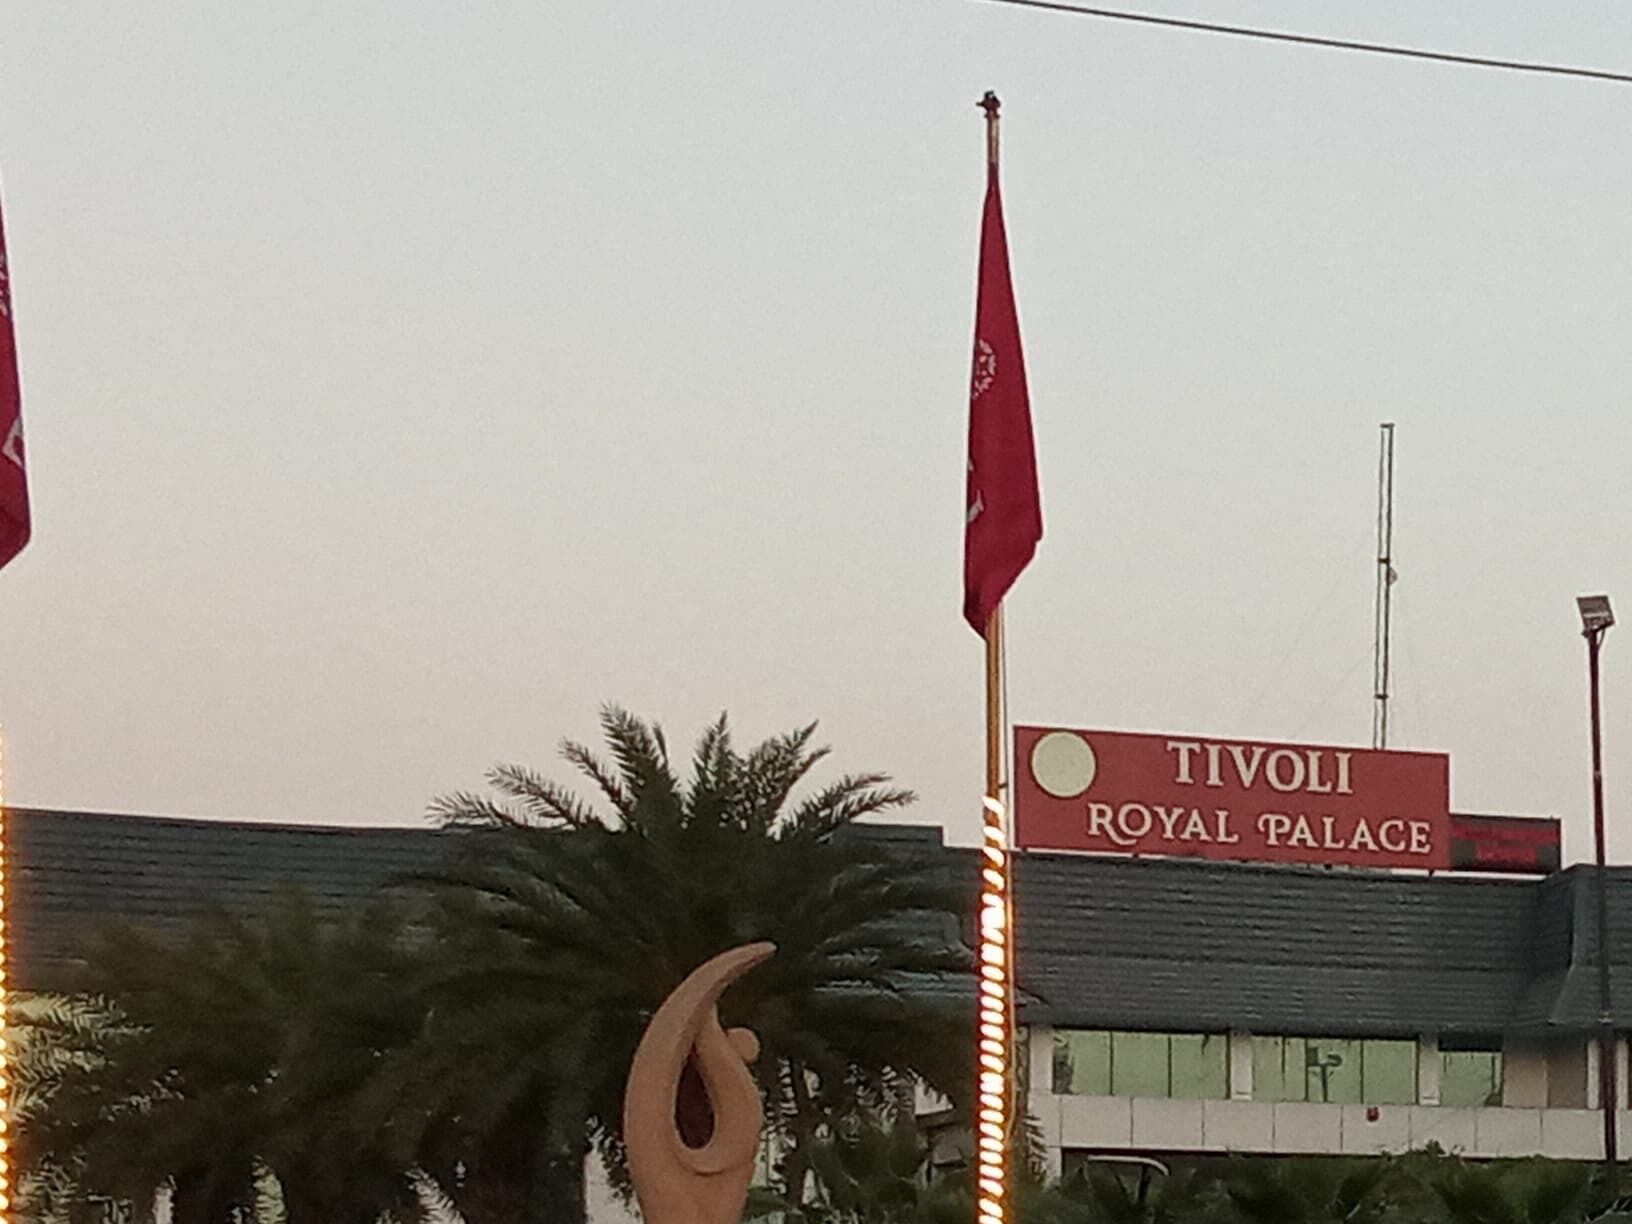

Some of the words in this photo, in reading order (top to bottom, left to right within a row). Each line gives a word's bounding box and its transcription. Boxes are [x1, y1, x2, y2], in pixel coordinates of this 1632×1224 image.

[1165, 739, 1354, 795] TIVOLI
[1087, 802, 1240, 846] ROYAL
[1257, 812, 1432, 855] PALACE
